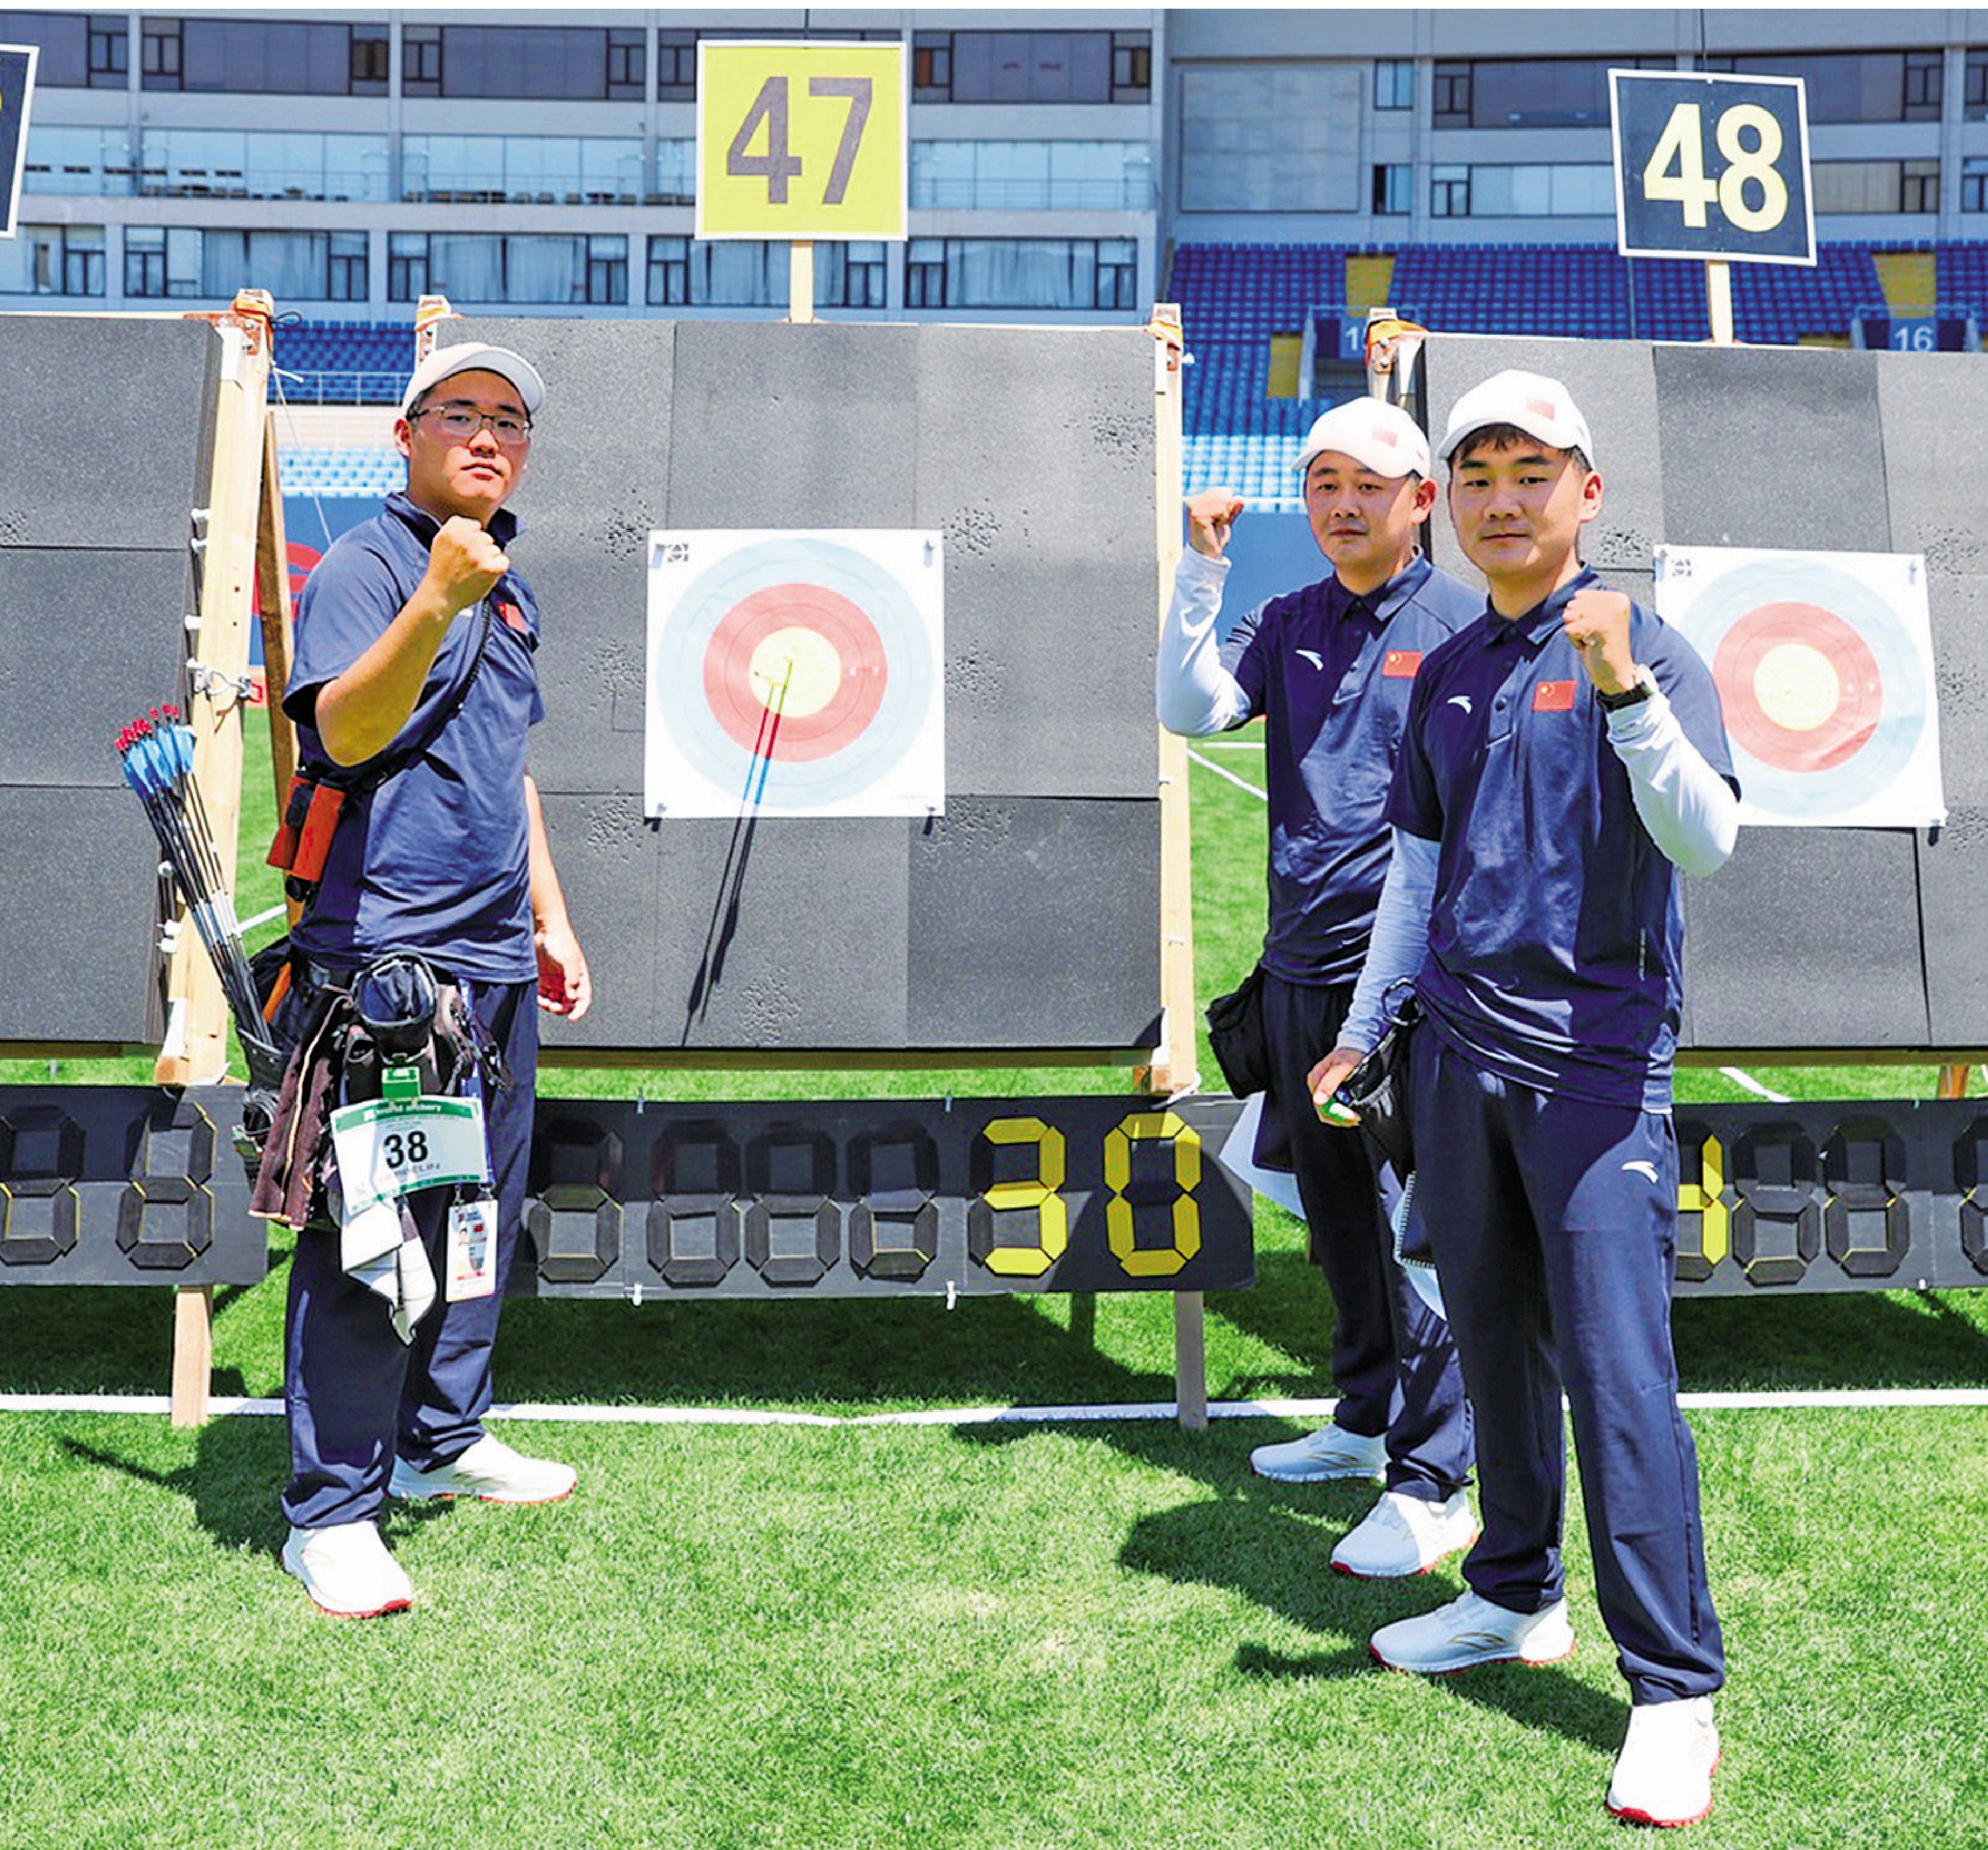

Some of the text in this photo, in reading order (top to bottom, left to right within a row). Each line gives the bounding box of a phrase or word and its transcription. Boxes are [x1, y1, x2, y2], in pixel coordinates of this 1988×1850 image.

[727, 76, 872, 205] 47
[1643, 103, 1788, 232] 48
[1345, 327, 1368, 350] 1
[1895, 327, 1933, 352] 16
[383, 1131, 429, 1169] 38
[982, 1111, 1202, 1278] 30
